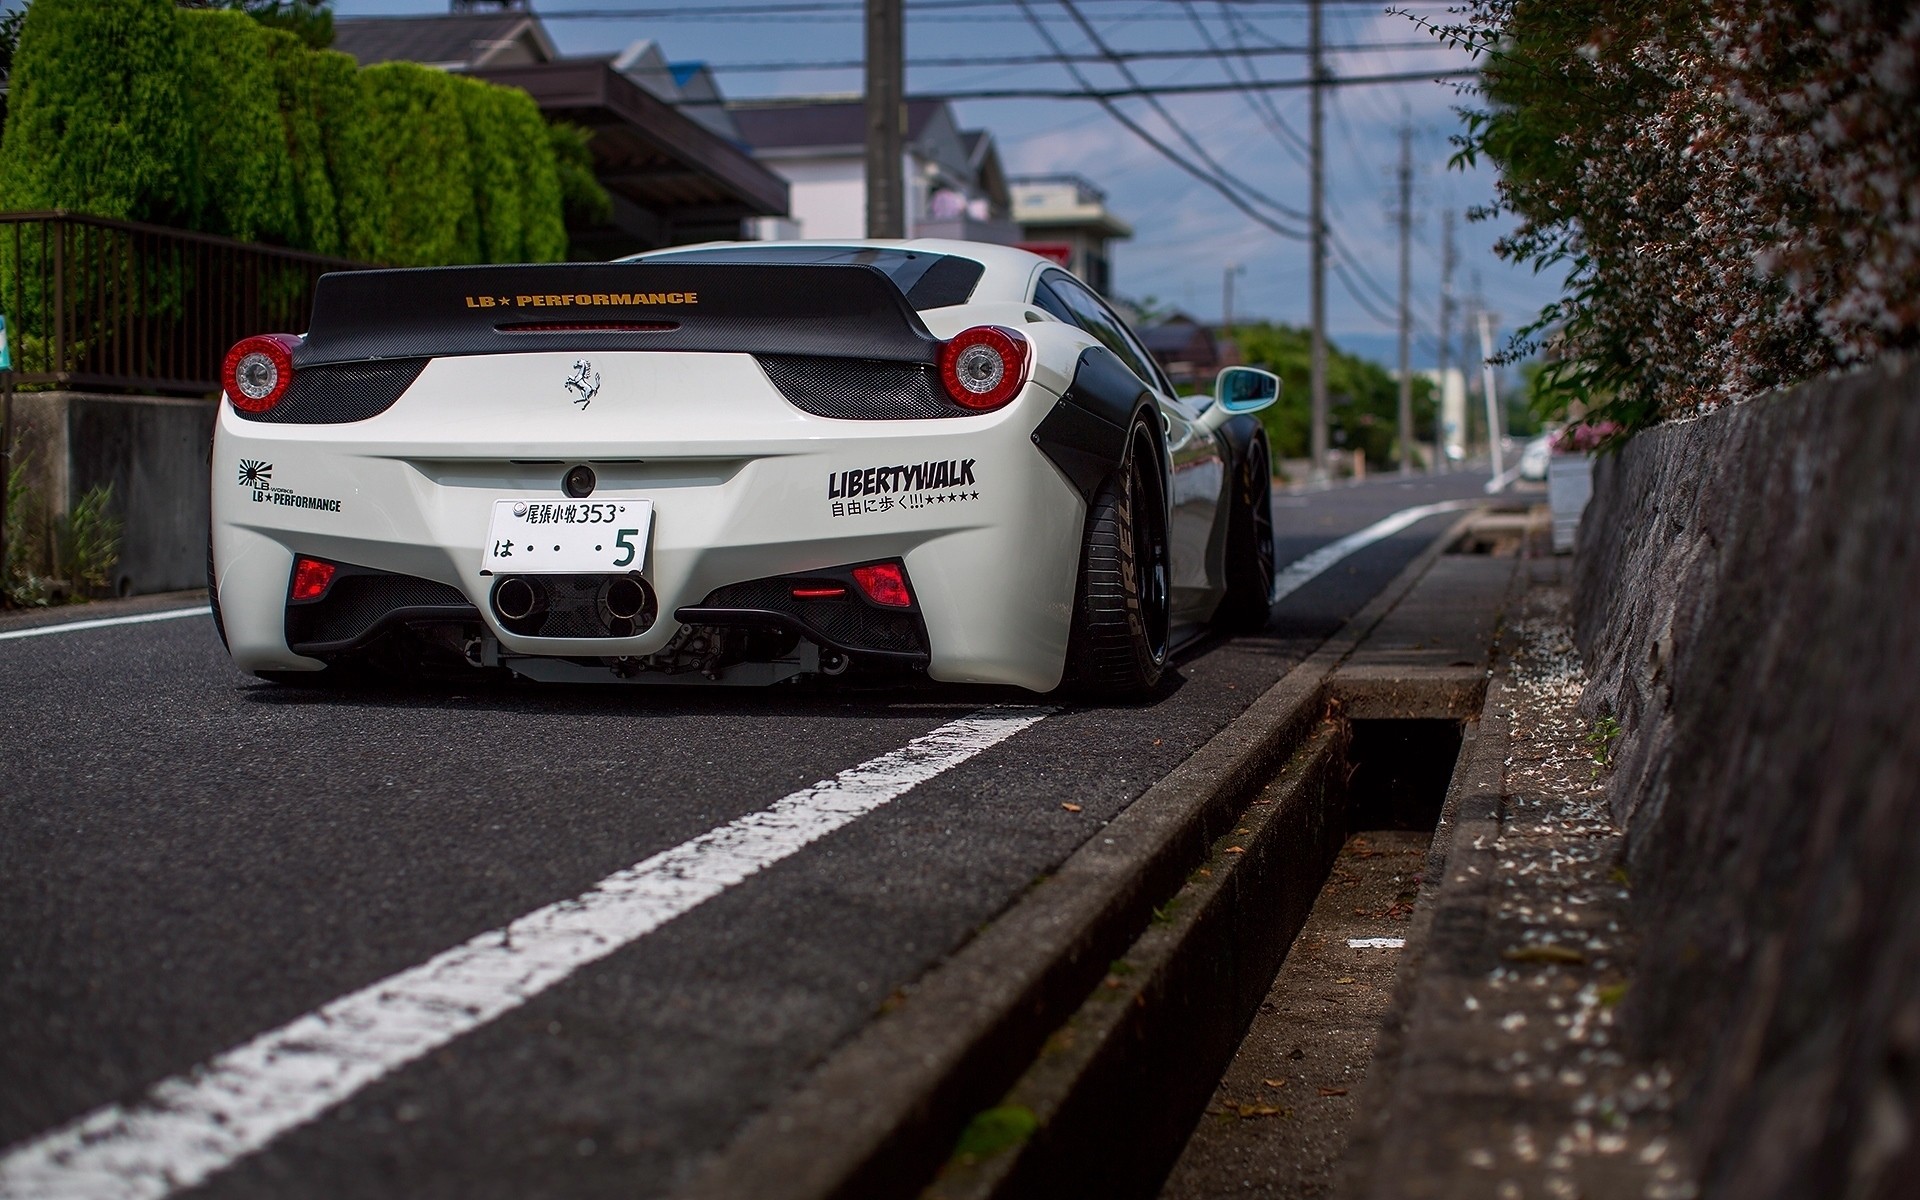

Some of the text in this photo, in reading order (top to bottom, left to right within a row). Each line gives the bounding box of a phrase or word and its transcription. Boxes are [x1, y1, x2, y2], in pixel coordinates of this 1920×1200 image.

[466, 293, 698, 307] LB PERFORMANCE
[829, 459, 975, 499] LIBERTYWALK
[253, 490, 341, 512] LB PERFORMANCE
[494, 529, 639, 566] は 5
